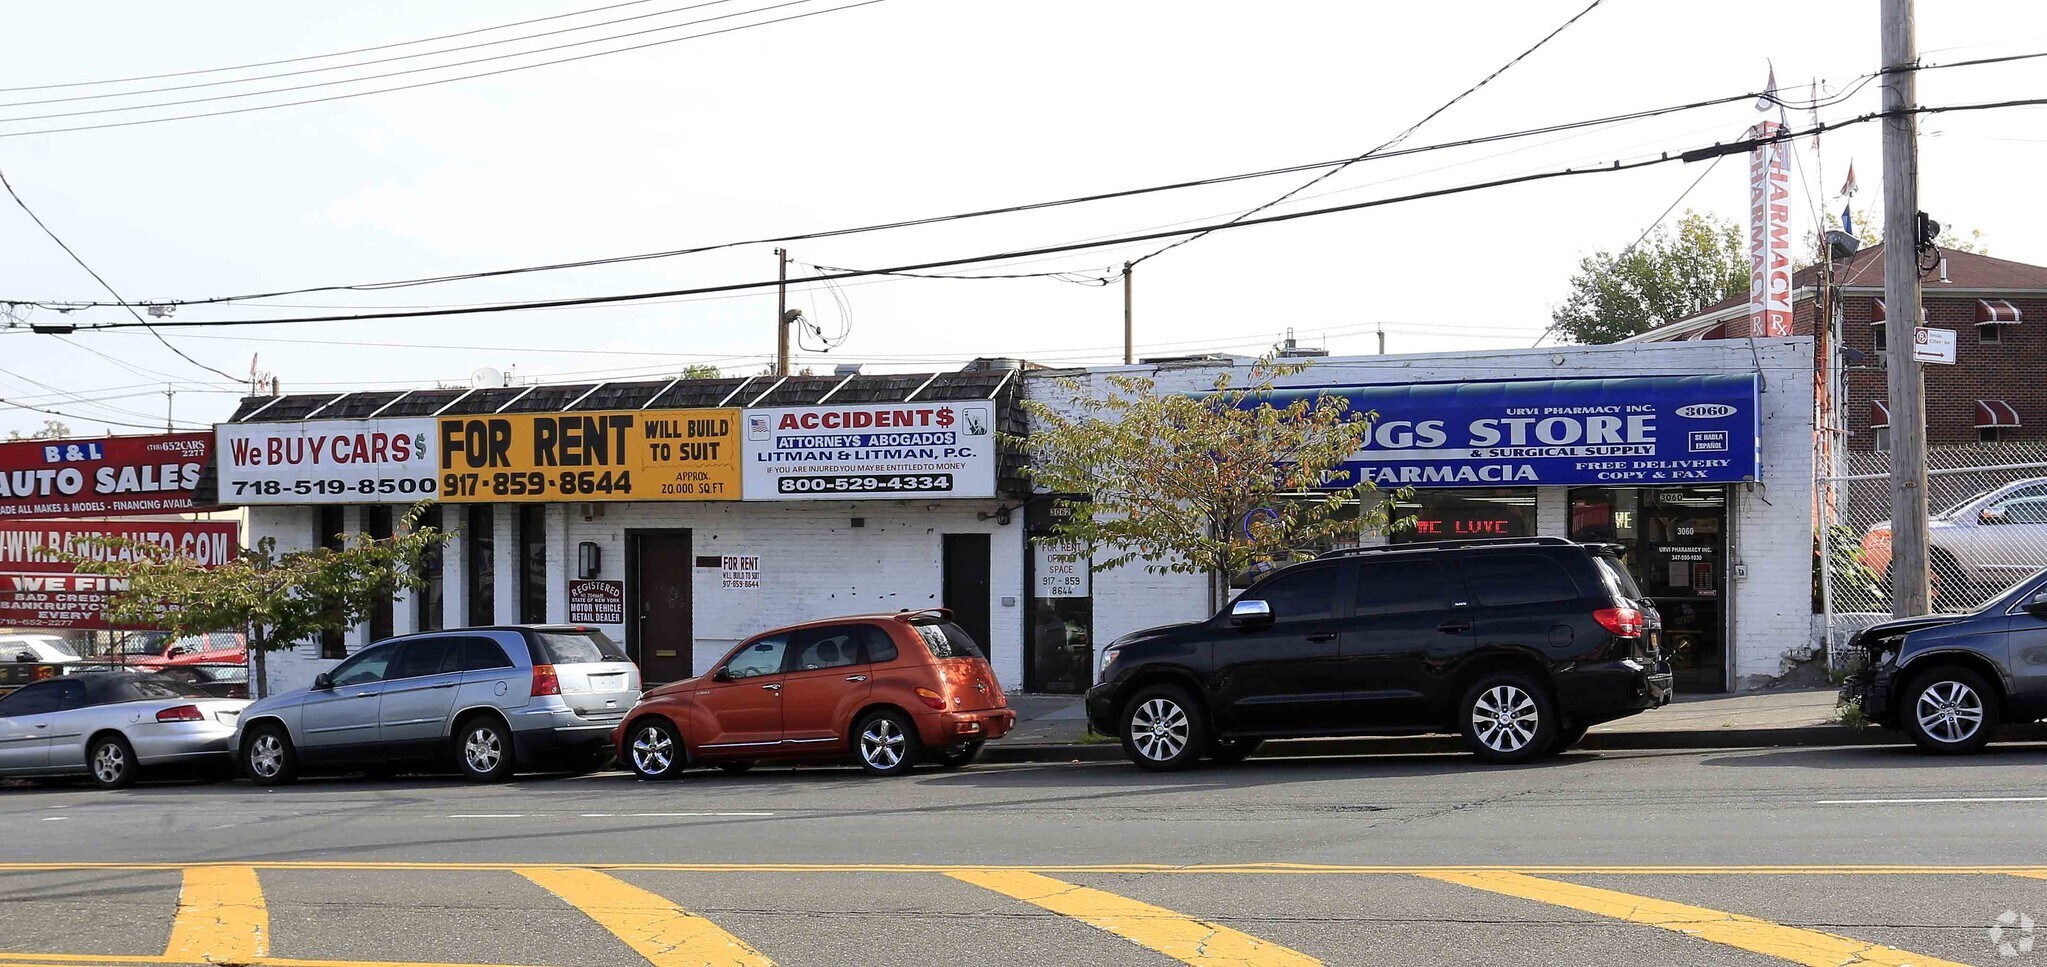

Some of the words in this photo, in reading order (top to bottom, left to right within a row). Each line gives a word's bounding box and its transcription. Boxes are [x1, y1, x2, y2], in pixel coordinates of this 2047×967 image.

[1544, 406, 1621, 415] PHARMACY
[1626, 404, 1656, 412] INC.
[1685, 406, 1729, 416] 3060
[778, 406, 955, 430] ACCIDENT$
[645, 420, 682, 439] WILL
[687, 419, 728, 438] BUILD
[1469, 414, 1656, 448] STORE
[441, 419, 512, 469] FOR
[533, 415, 634, 467] RENT
[779, 435, 862, 449] ATTORNEYS
[868, 432, 954, 447] ABOGADOS
[1694, 433, 1703, 441] SE
[1703, 433, 1723, 441] HABLA
[1695, 440, 1722, 449] ESPAÑOL
[45, 446, 61, 463] B
[66, 444, 86, 461] &
[90, 443, 102, 460] L
[230, 437, 262, 466] We
[267, 436, 327, 465] BUY
[650, 443, 671, 461] TO
[680, 442, 720, 461] SUIT
[757, 450, 833, 462] LITMAN
[837, 450, 852, 461] &
[855, 448, 939, 461] LITMAN,
[944, 447, 977, 458] P.C.
[1470, 449, 1483, 457] &
[1489, 447, 1579, 457] SURGICAL
[1585, 445, 1654, 456] SUPPLY
[775, 466, 790, 474] YOU
[809, 465, 839, 473] INJURED
[857, 464, 875, 472] MAY
[886, 463, 923, 471] ENTITLED
[923, 463, 934, 471] TO
[936, 462, 966, 471] MONEY
[1575, 461, 1628, 470] FREE
[1633, 459, 1732, 469] DELIVERY
[95, 462, 200, 494] SALES
[675, 471, 711, 482] APPROX.
[1360, 464, 1540, 483] FARMACIA
[1597, 471, 1647, 480] COPY
[1652, 470, 1667, 479] &
[1672, 470, 1708, 479] FAX
[232, 477, 437, 496] 718-519-8500
[781, 476, 950, 492] 800-529-4334
[1660, 493, 1683, 502] 3060
[18, 503, 33, 514] ALL
[34, 503, 61, 513] MAKES
[63, 503, 70, 512] &
[72, 502, 105, 511] MODELS
[113, 500, 160, 510] FINANCING
[162, 499, 193, 509] AVAILA
[1677, 527, 1694, 535] 3060
[1042, 543, 1057, 552] FOR
[1062, 543, 1081, 552] RENT
[723, 556, 738, 570] FOR
[741, 556, 758, 570] RENT
[1049, 566, 1073, 574] SPACE
[11, 577, 66, 592] WE
[1042, 577, 1055, 585] 917
[571, 581, 620, 597] REGISTERED
[1052, 587, 1073, 595] 8644
[14, 593, 48, 602] BAD
[571, 603, 593, 612] MOTOR
[595, 603, 621, 613] VEHICLE
[38, 611, 92, 620] EVERY
[572, 613, 593, 621] RETAIL
[595, 613, 620, 622] DEALER
